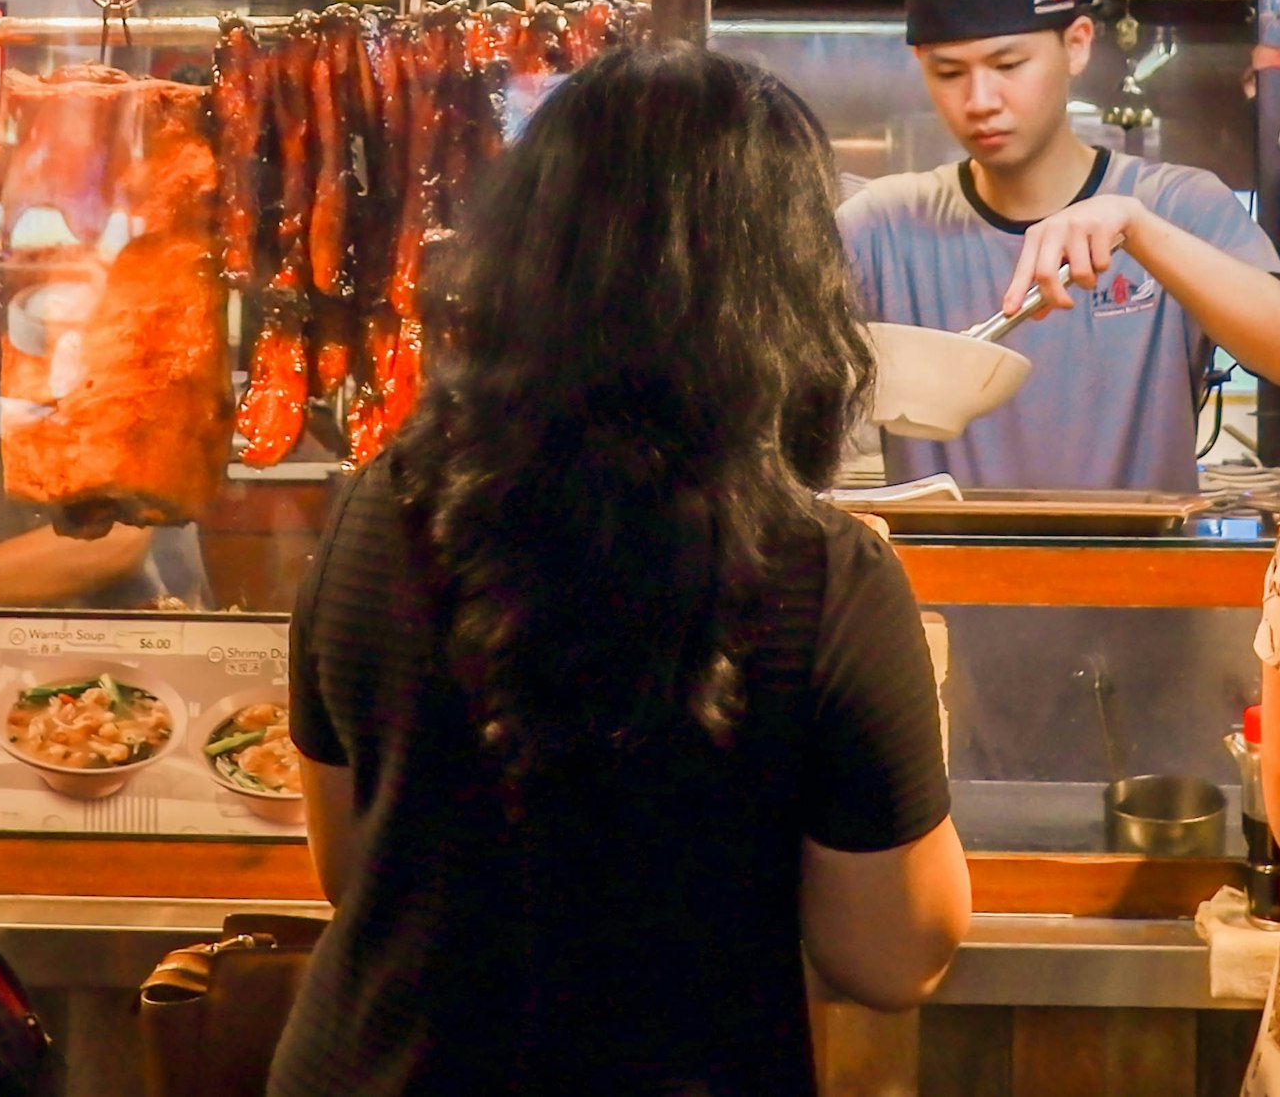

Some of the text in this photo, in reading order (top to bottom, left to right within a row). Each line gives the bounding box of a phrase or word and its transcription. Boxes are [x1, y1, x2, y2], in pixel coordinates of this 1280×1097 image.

[28, 629, 73, 640] Wanton
[76, 629, 106, 642] Soup
[139, 638, 171, 650] $6.00
[227, 647, 267, 659] Shrimp
[271, 648, 287, 659] Du
